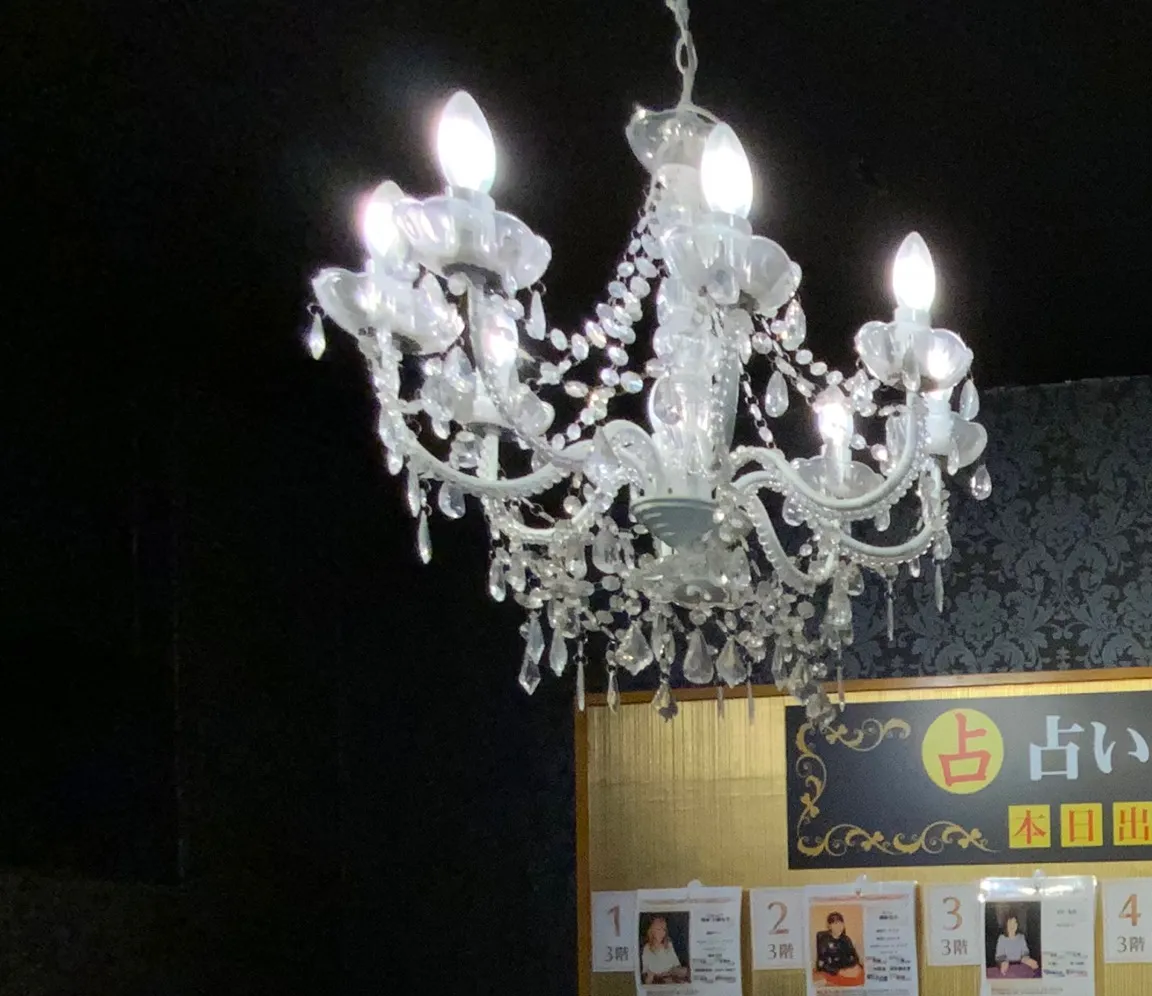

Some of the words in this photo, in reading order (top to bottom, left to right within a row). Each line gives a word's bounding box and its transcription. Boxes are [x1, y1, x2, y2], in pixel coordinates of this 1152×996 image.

[938, 713, 991, 785] 占
[607, 905, 621, 937] 1
[767, 902, 789, 935] 2
[942, 897, 962, 931] 3
[1119, 894, 1141, 926] 4
[605, 945, 629, 962] 3階
[767, 943, 794, 960] 3階
[941, 939, 968, 956] 3階
[1117, 935, 1145, 953] 3階
